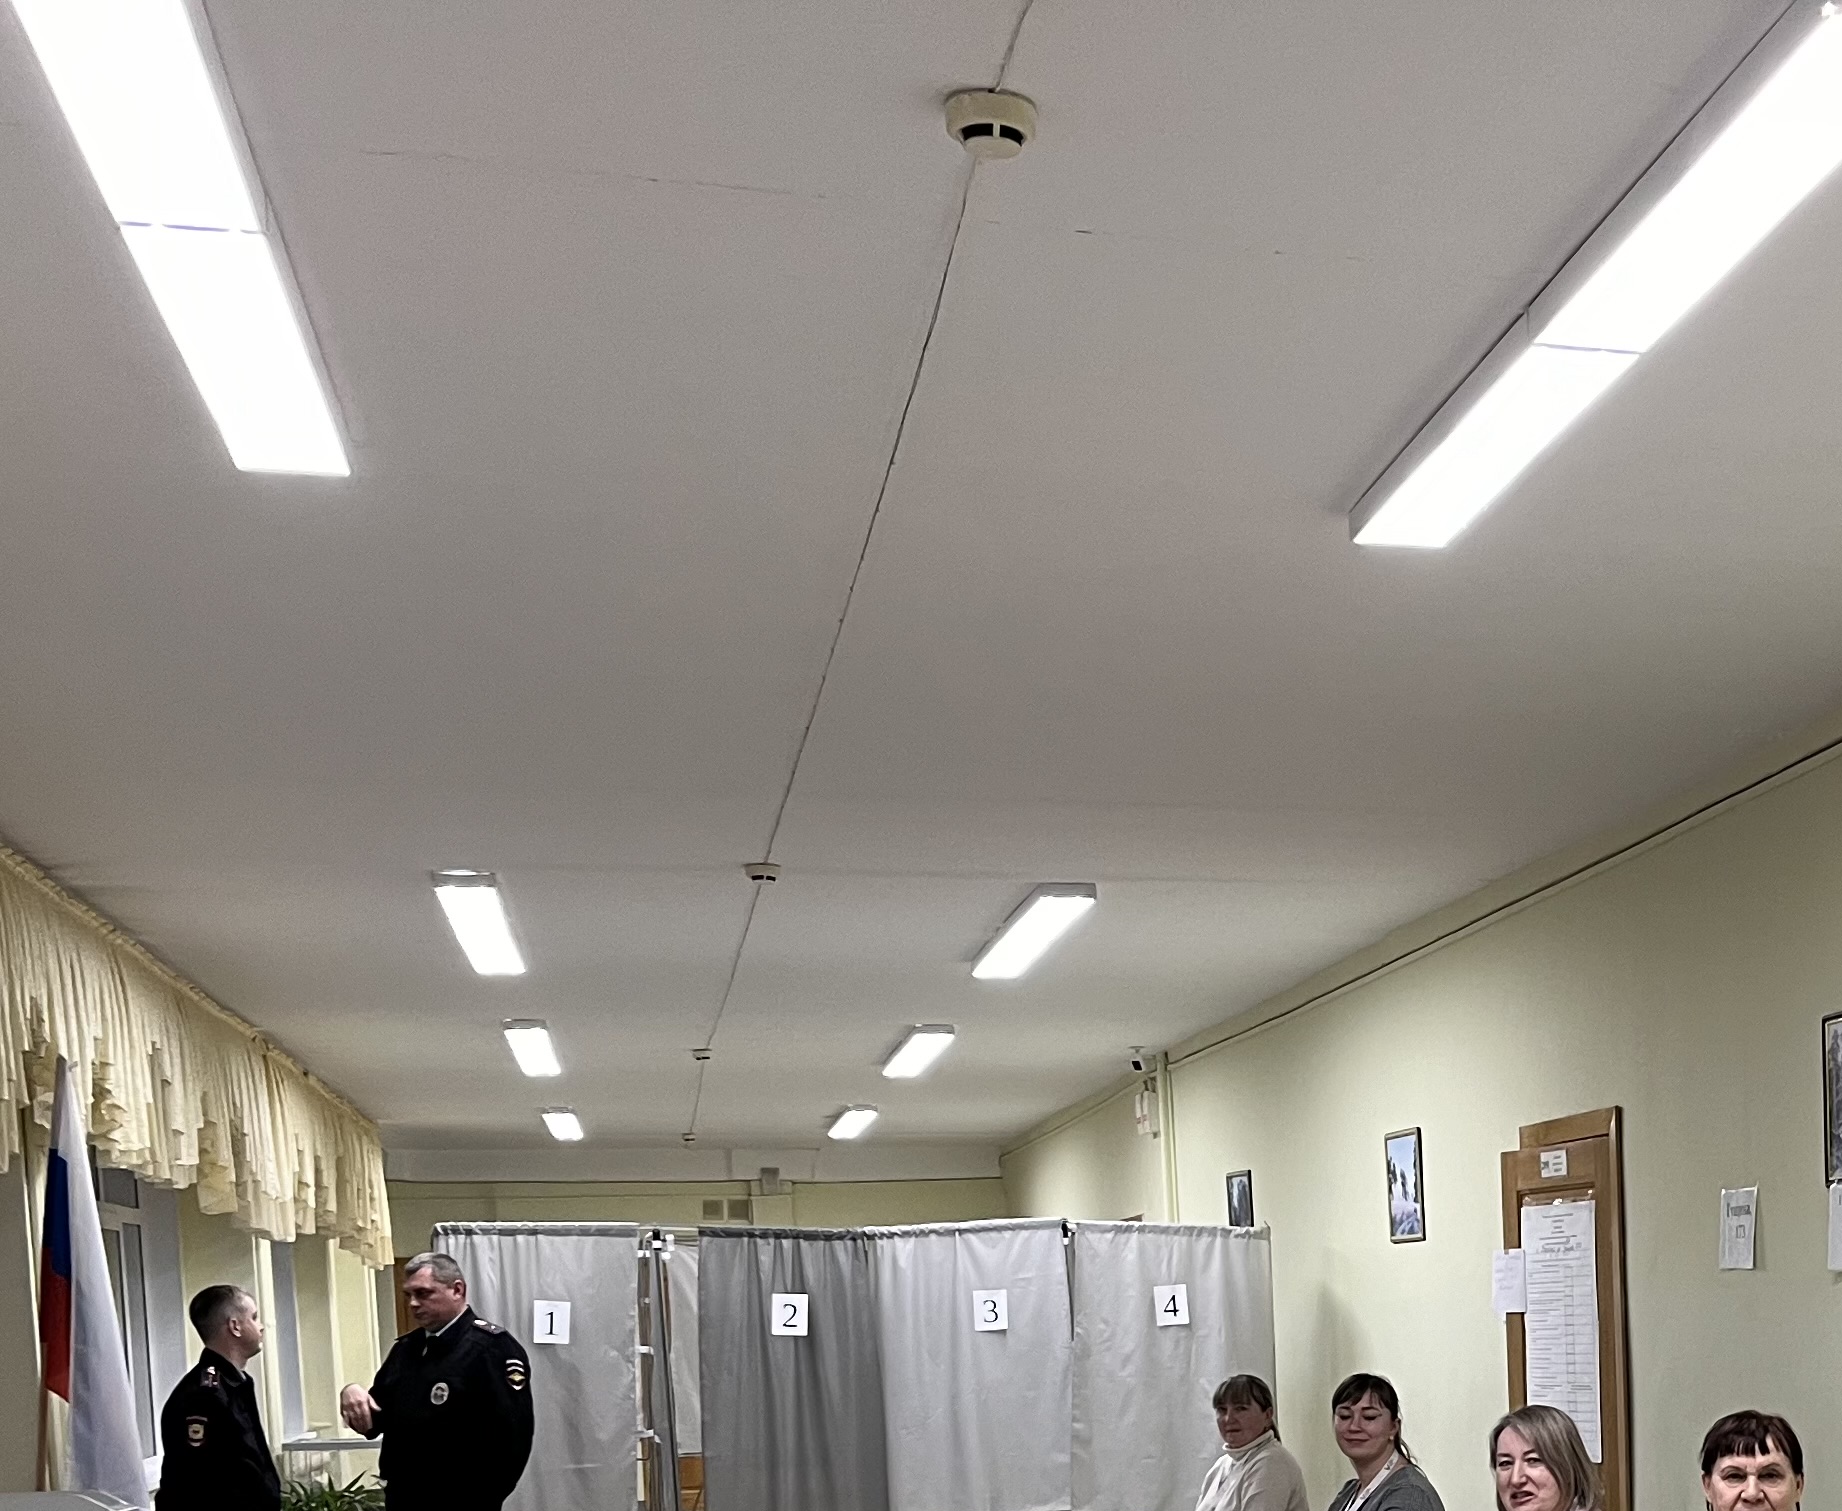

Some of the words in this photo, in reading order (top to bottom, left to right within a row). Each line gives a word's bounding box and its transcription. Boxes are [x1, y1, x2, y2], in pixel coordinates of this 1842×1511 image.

[782, 1303, 798, 1328] 2
[983, 1299, 999, 1323] 3
[1164, 1294, 1180, 1317] 4
[544, 1311, 558, 1336] 1
